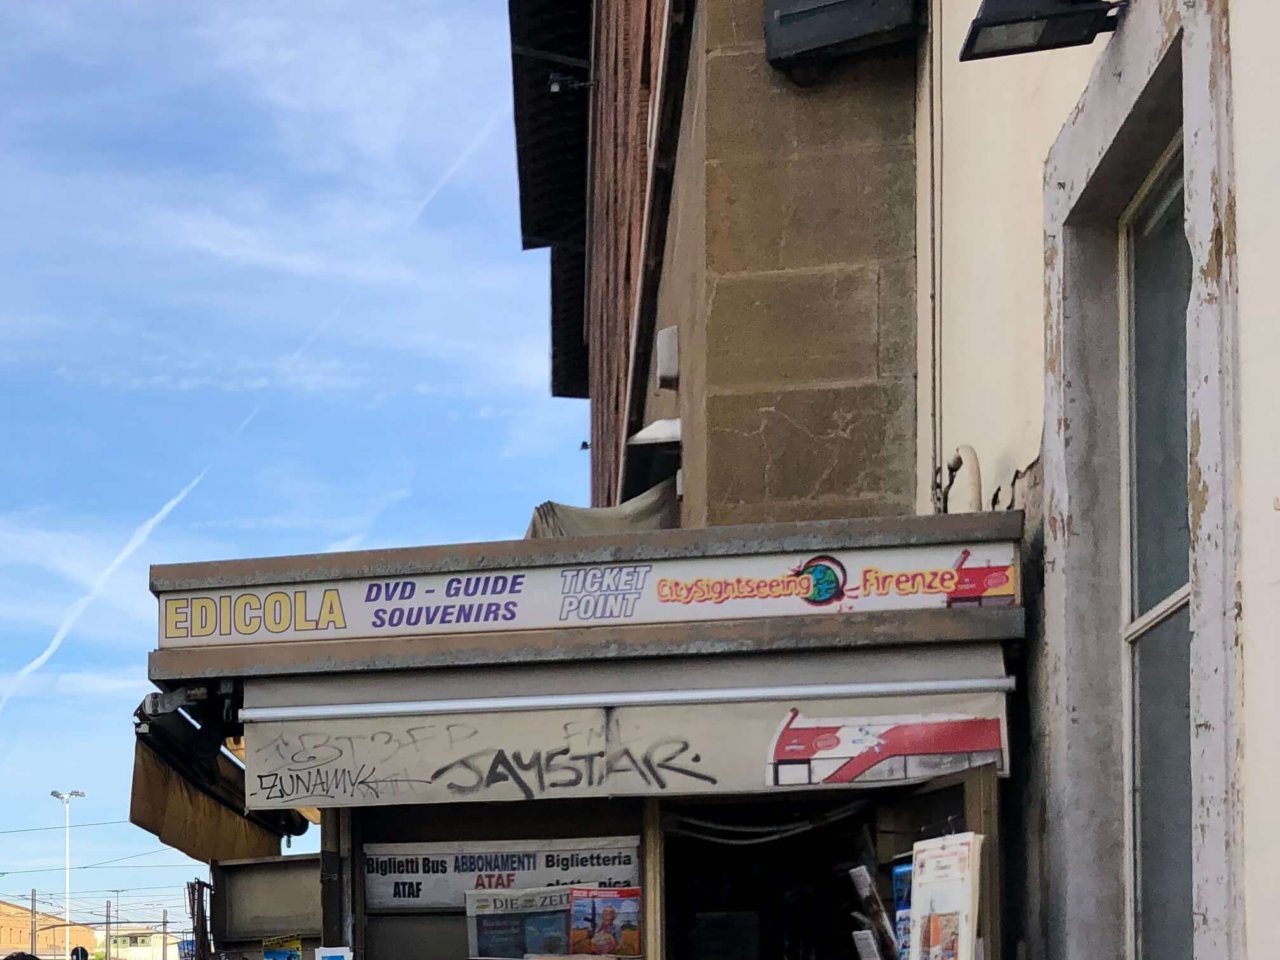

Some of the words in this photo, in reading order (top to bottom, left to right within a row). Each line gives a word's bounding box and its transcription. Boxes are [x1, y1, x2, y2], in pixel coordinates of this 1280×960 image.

[365, 580, 418, 604] DVD
[445, 573, 526, 599] GUIDE
[560, 564, 653, 596] TICKET
[656, 570, 813, 604] CitySightseeing
[862, 567, 958, 596] Firenze
[164, 588, 348, 640] EDICOLA
[371, 601, 518, 629] SOUVENIRS
[559, 591, 642, 622] POINT
[367, 857, 420, 875] Biglietti
[422, 858, 448, 875] Bus
[454, 853, 538, 874] ABBONAMENTI
[545, 852, 632, 870] Biglietteria
[393, 881, 423, 899] ATAF
[474, 873, 516, 890] ATAF
[493, 898, 521, 911] DIE
